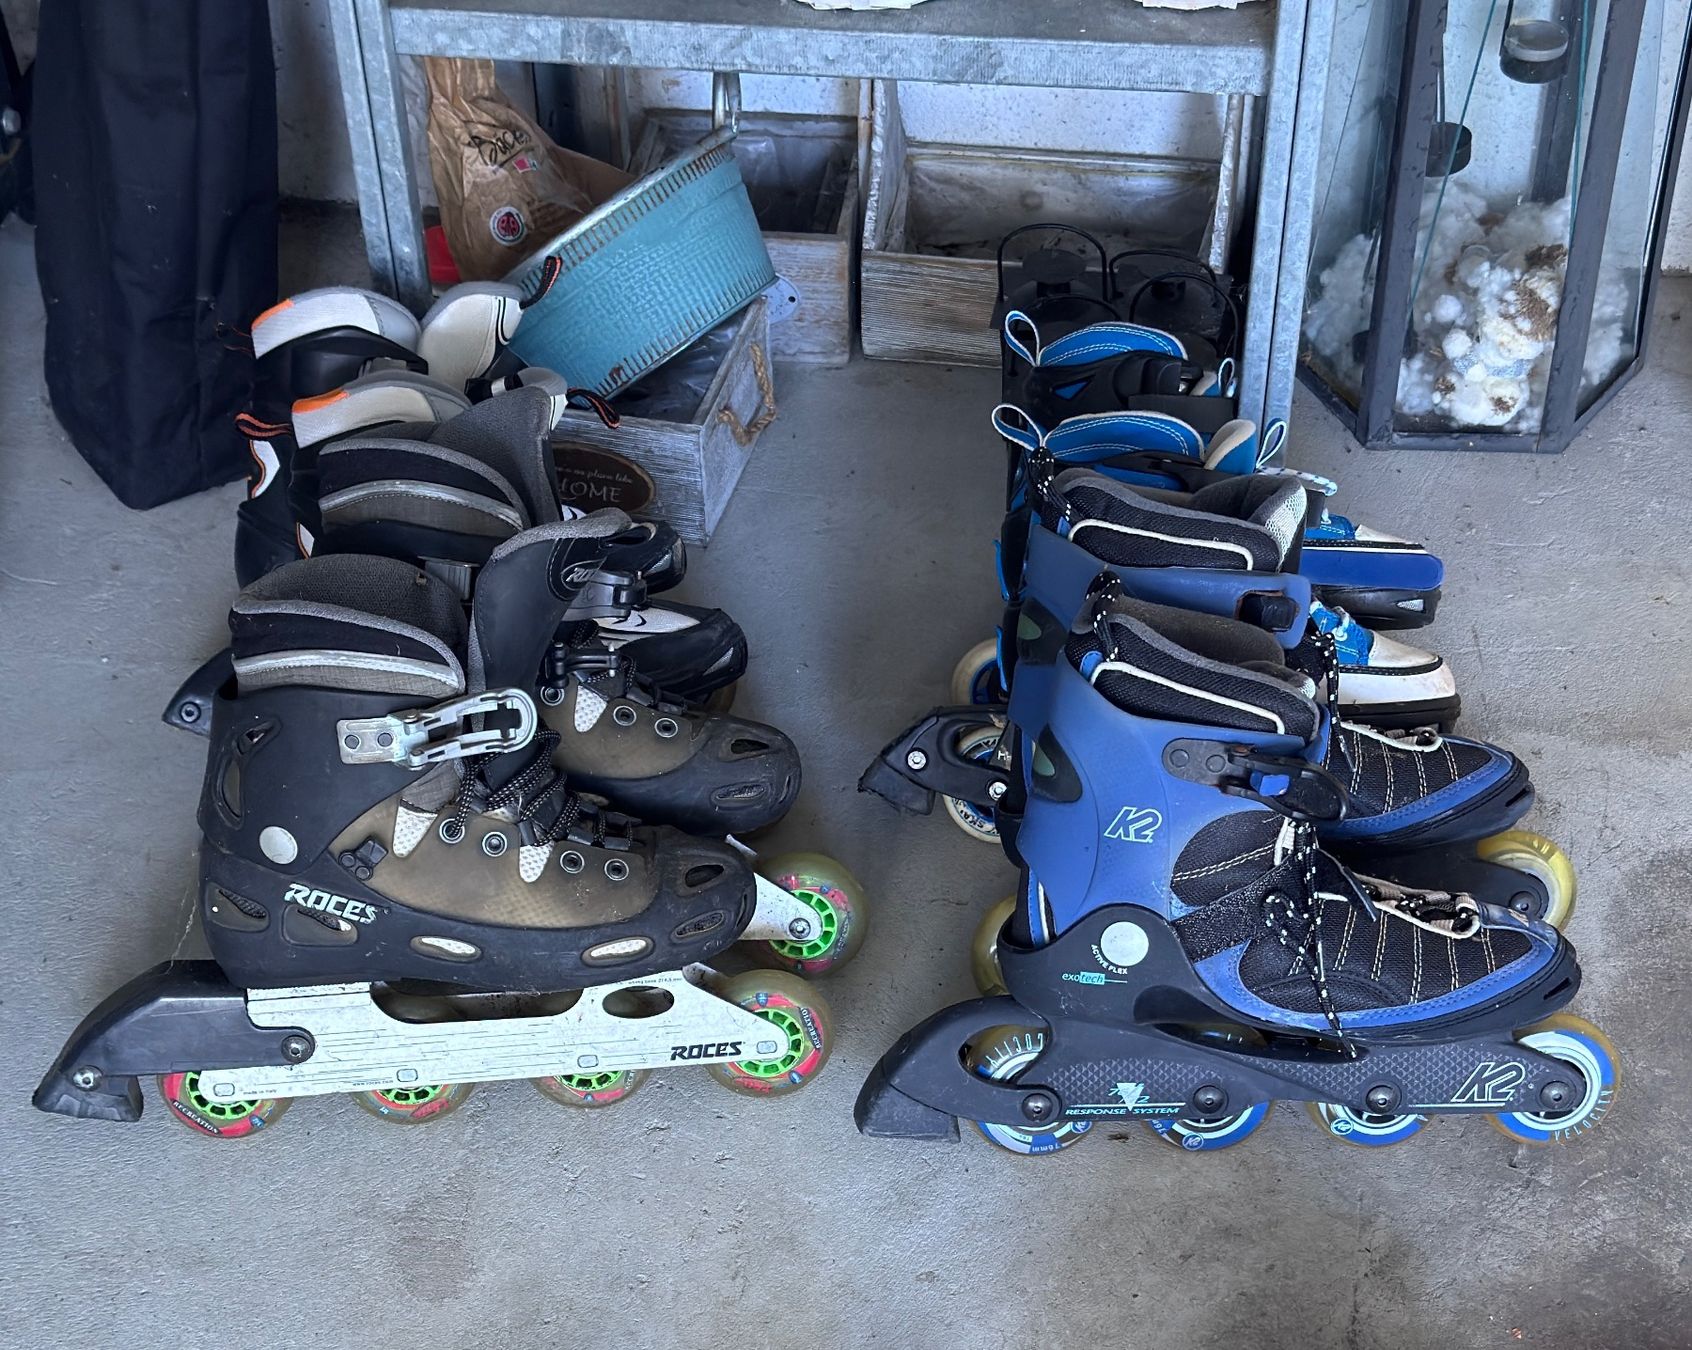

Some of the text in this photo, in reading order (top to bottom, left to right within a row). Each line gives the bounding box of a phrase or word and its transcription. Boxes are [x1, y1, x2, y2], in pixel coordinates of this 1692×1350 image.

[1103, 806, 1163, 843] K2
[284, 883, 378, 925] ROCES
[1090, 944, 1128, 975] ACTIVE FLEX
[1061, 971, 1106, 985] exotech
[670, 1041, 742, 1061] ROCES
[1450, 1062, 1526, 1102] K2
[172, 1101, 219, 1135] RECREATION
